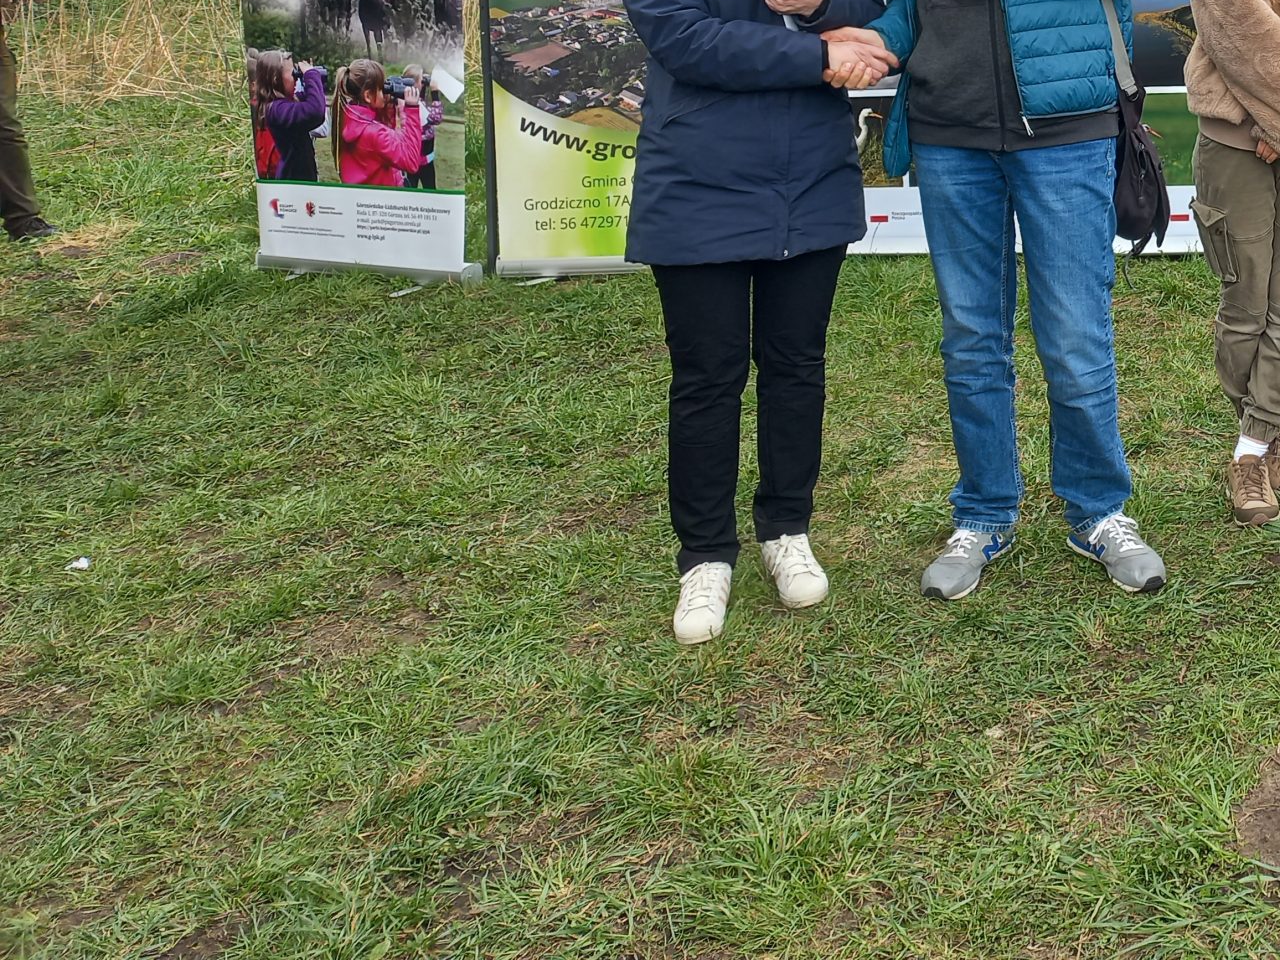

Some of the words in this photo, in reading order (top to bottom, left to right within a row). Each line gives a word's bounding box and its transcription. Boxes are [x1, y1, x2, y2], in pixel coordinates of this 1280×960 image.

[581, 175, 626, 188] Gmina
[524, 197, 601, 211] Grodziczno
[605, 195, 631, 208] 17A
[535, 218, 556, 230] tel:
[560, 217, 576, 230] 56
